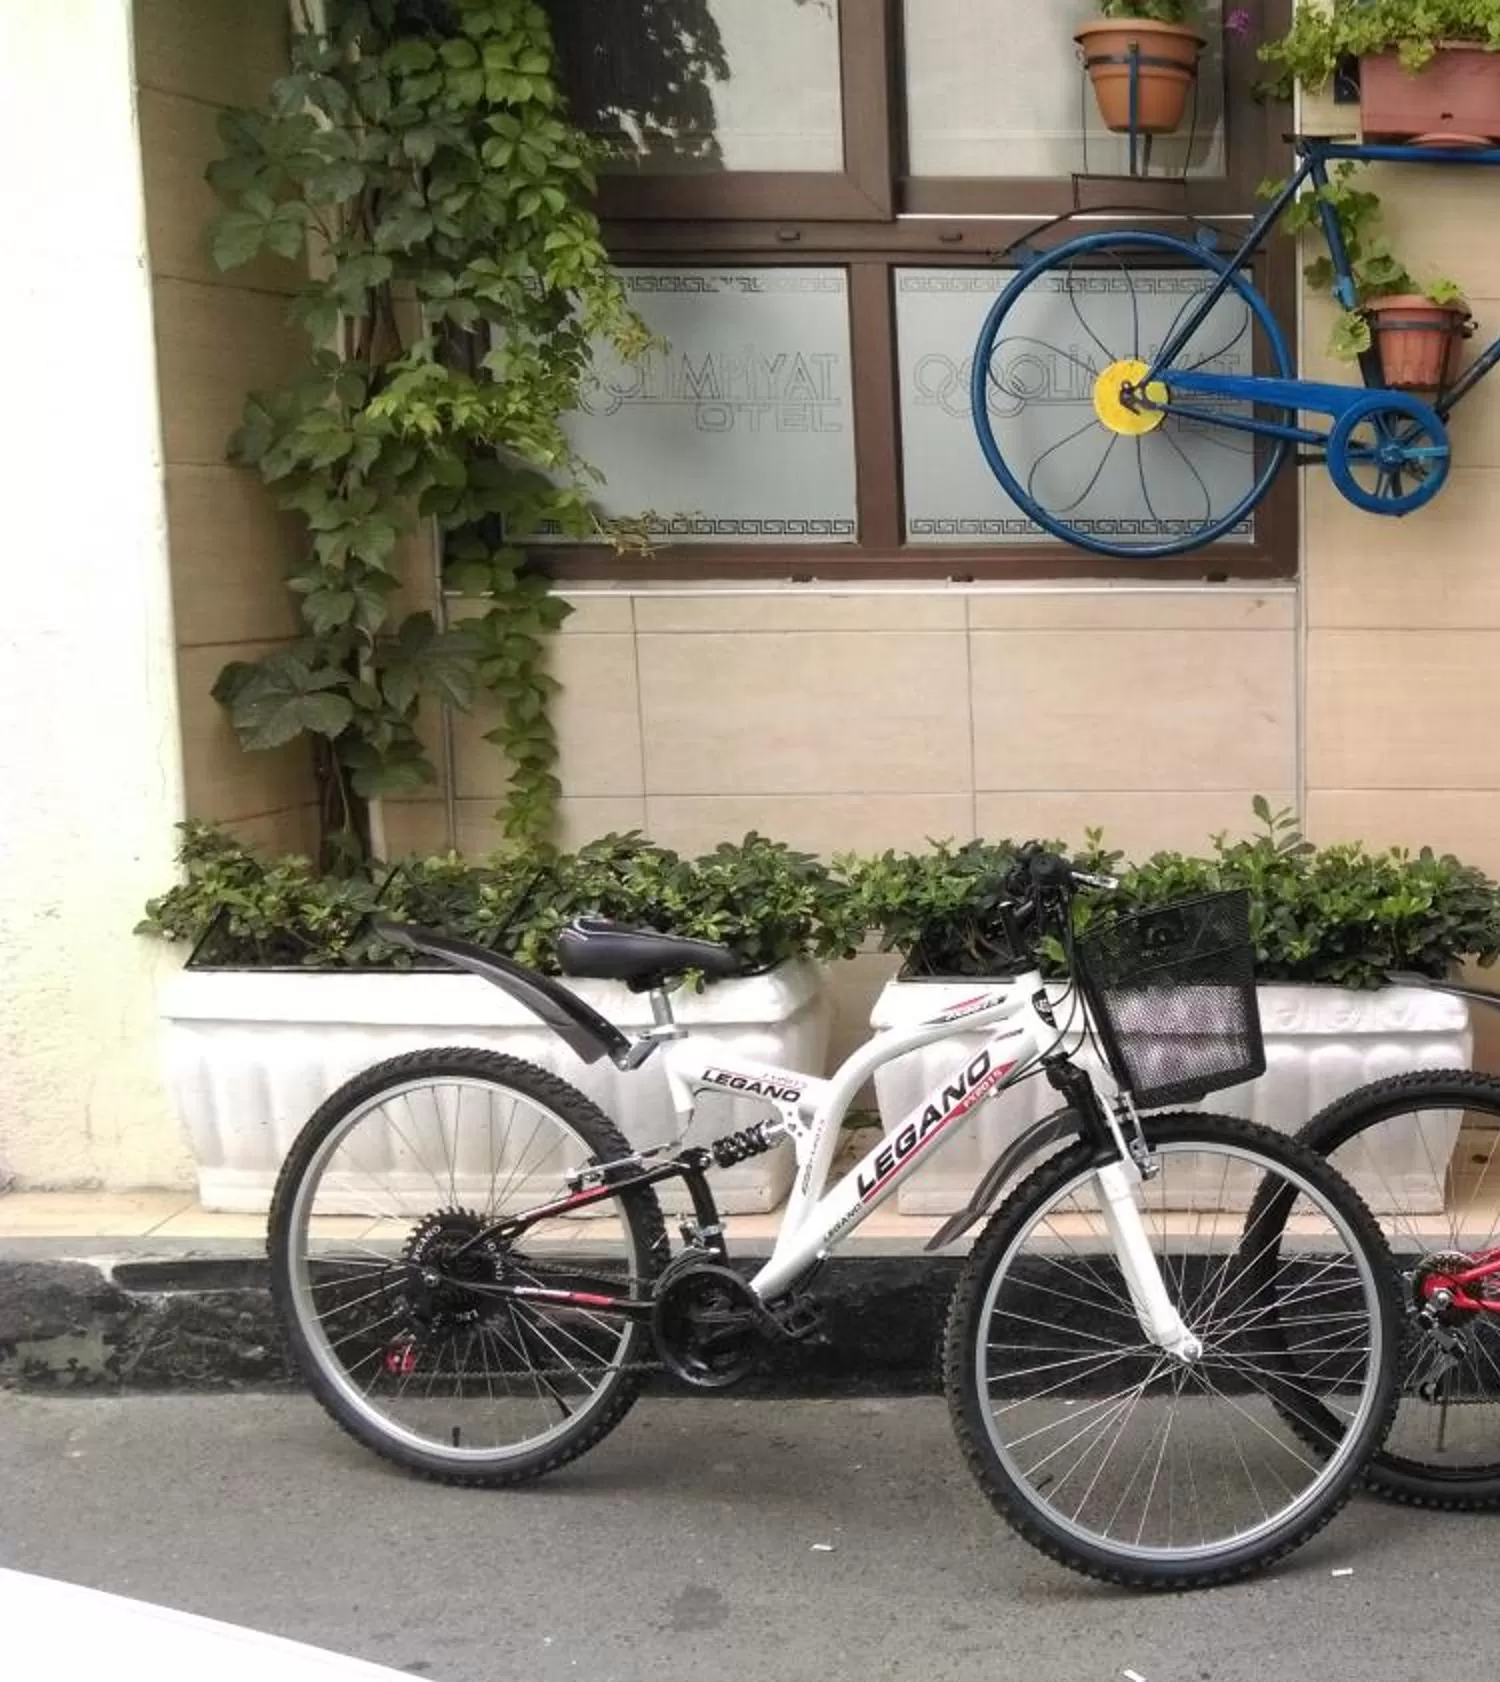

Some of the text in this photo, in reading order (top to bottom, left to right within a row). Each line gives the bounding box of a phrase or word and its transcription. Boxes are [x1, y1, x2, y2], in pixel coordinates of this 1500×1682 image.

[696, 402, 844, 433] OTEL
[701, 1069, 801, 1103] LEGANO
[857, 1049, 991, 1198] LEGANO
